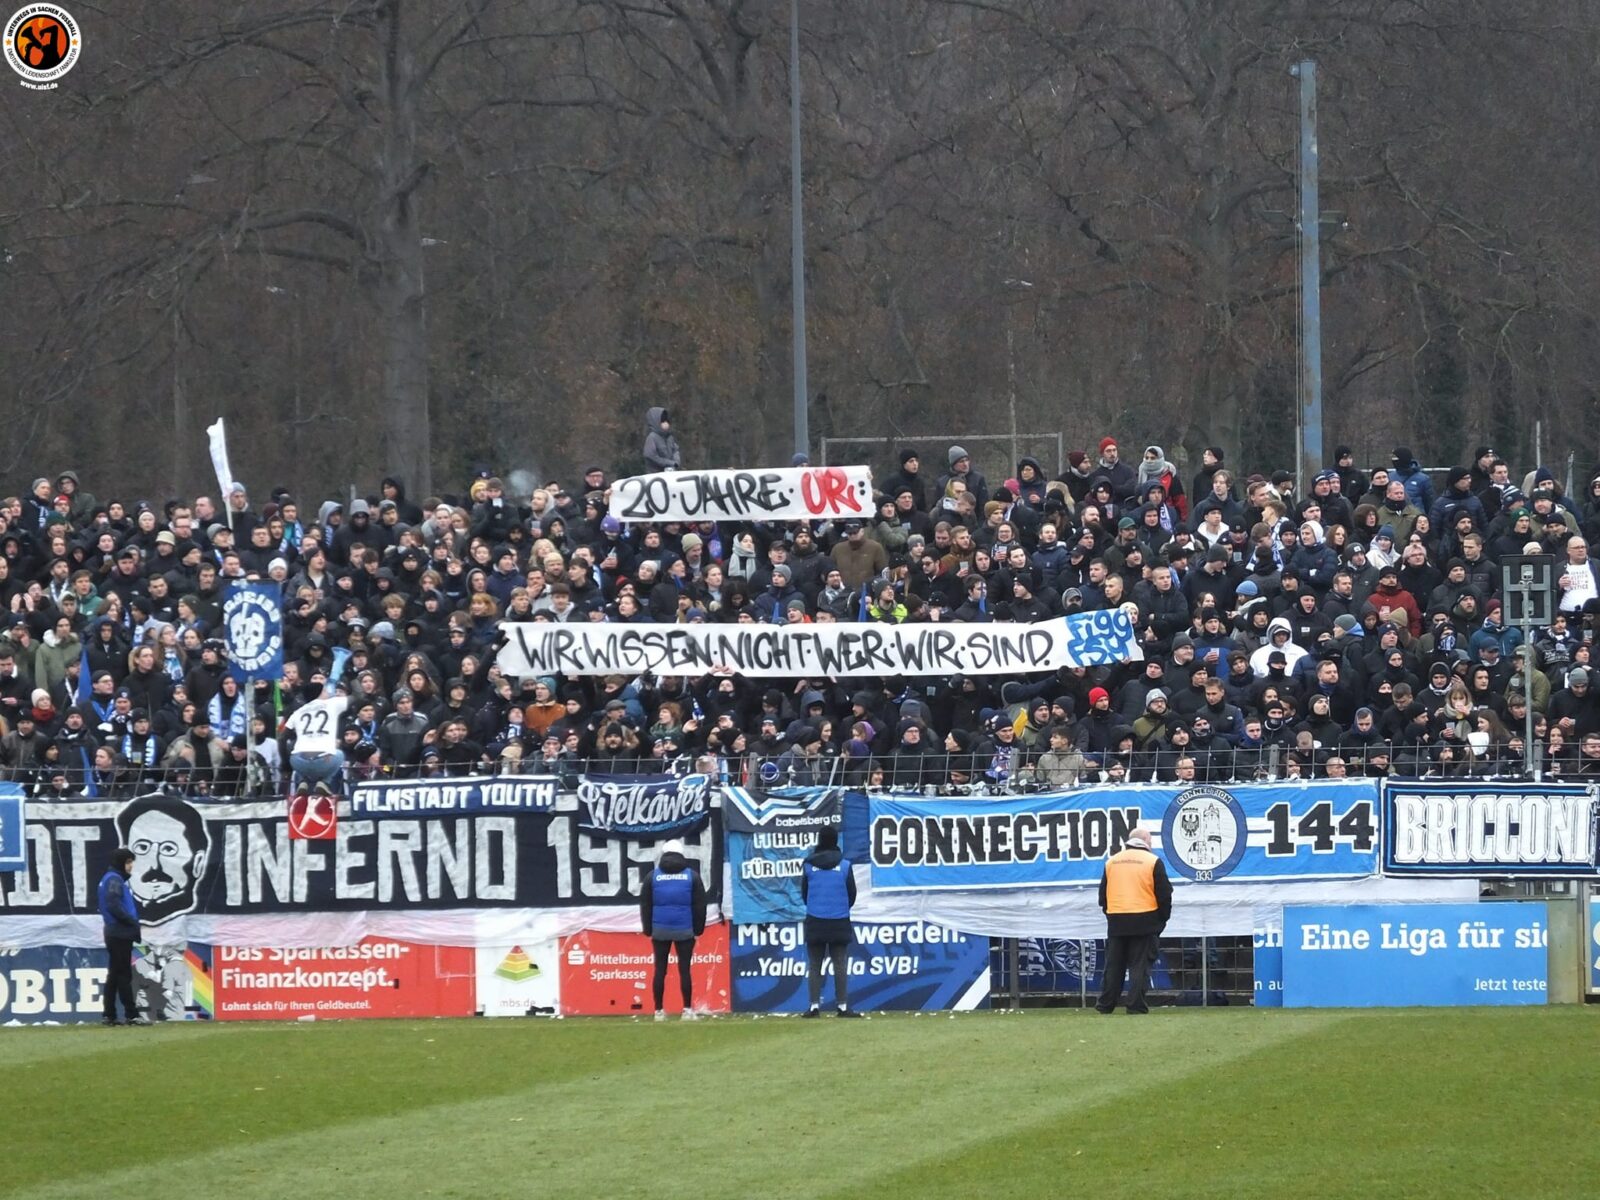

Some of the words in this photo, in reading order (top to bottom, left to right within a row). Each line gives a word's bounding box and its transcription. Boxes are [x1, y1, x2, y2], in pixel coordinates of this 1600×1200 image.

[300, 709, 330, 736] 22
[353, 786, 473, 812] FILMSTADT
[479, 783, 554, 807] YOUTH
[1177, 786, 1232, 806] CONNECTION
[871, 806, 1140, 868] CONNECTION
[1264, 799, 1376, 858] 144
[0, 824, 100, 908] DT
[224, 817, 517, 905] INFERNO
[742, 857, 775, 879] FÜR
[656, 874, 688, 882] ORDNER
[1195, 870, 1213, 881] 144
[1301, 924, 1370, 950] Eine
[1380, 922, 1446, 956] Liga
[1458, 922, 1504, 949] für
[221, 946, 263, 962] Das
[590, 969, 646, 981] Sparkasse
[870, 956, 919, 975] SVB!
[221, 966, 395, 992] Finanzkonzept.
[1474, 977, 1507, 991] Jetzt
[222, 1001, 250, 1011] Lohnt
[252, 1001, 273, 1011] sich
[274, 1000, 288, 1012] für
[290, 1000, 315, 1010] Ihren
[316, 1000, 372, 1010] Geldbeutel.
